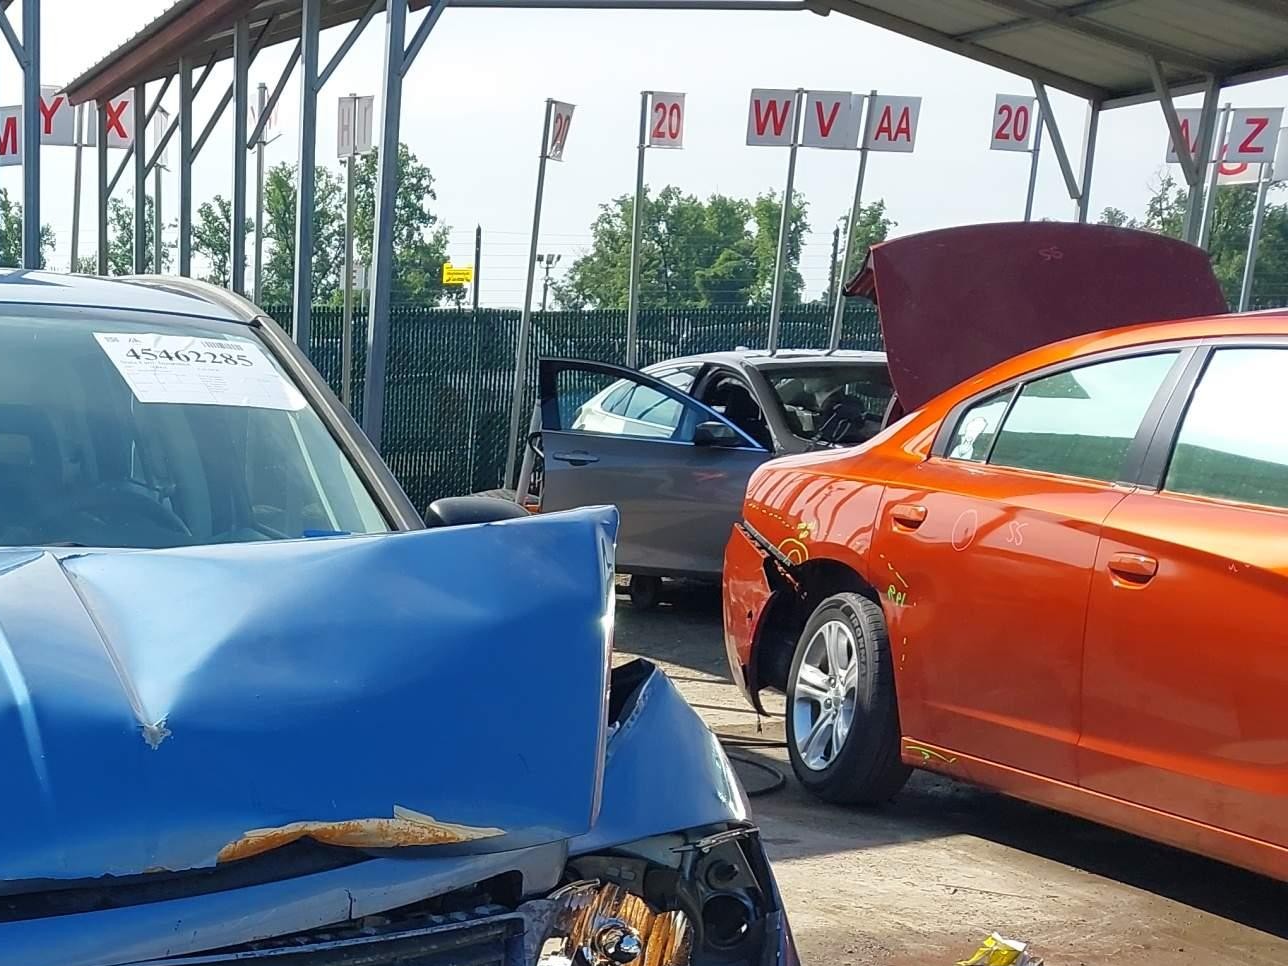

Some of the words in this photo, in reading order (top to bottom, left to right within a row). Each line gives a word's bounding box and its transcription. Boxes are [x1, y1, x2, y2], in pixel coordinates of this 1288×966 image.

[38, 96, 64, 135] Y
[106, 100, 130, 139] X
[651, 102, 682, 140] 20
[753, 99, 792, 136] W
[815, 101, 841, 138] V
[873, 105, 912, 142] AA
[994, 104, 1030, 142] 20
[1238, 117, 1270, 153] Z
[126, 348, 254, 367] 45462285
